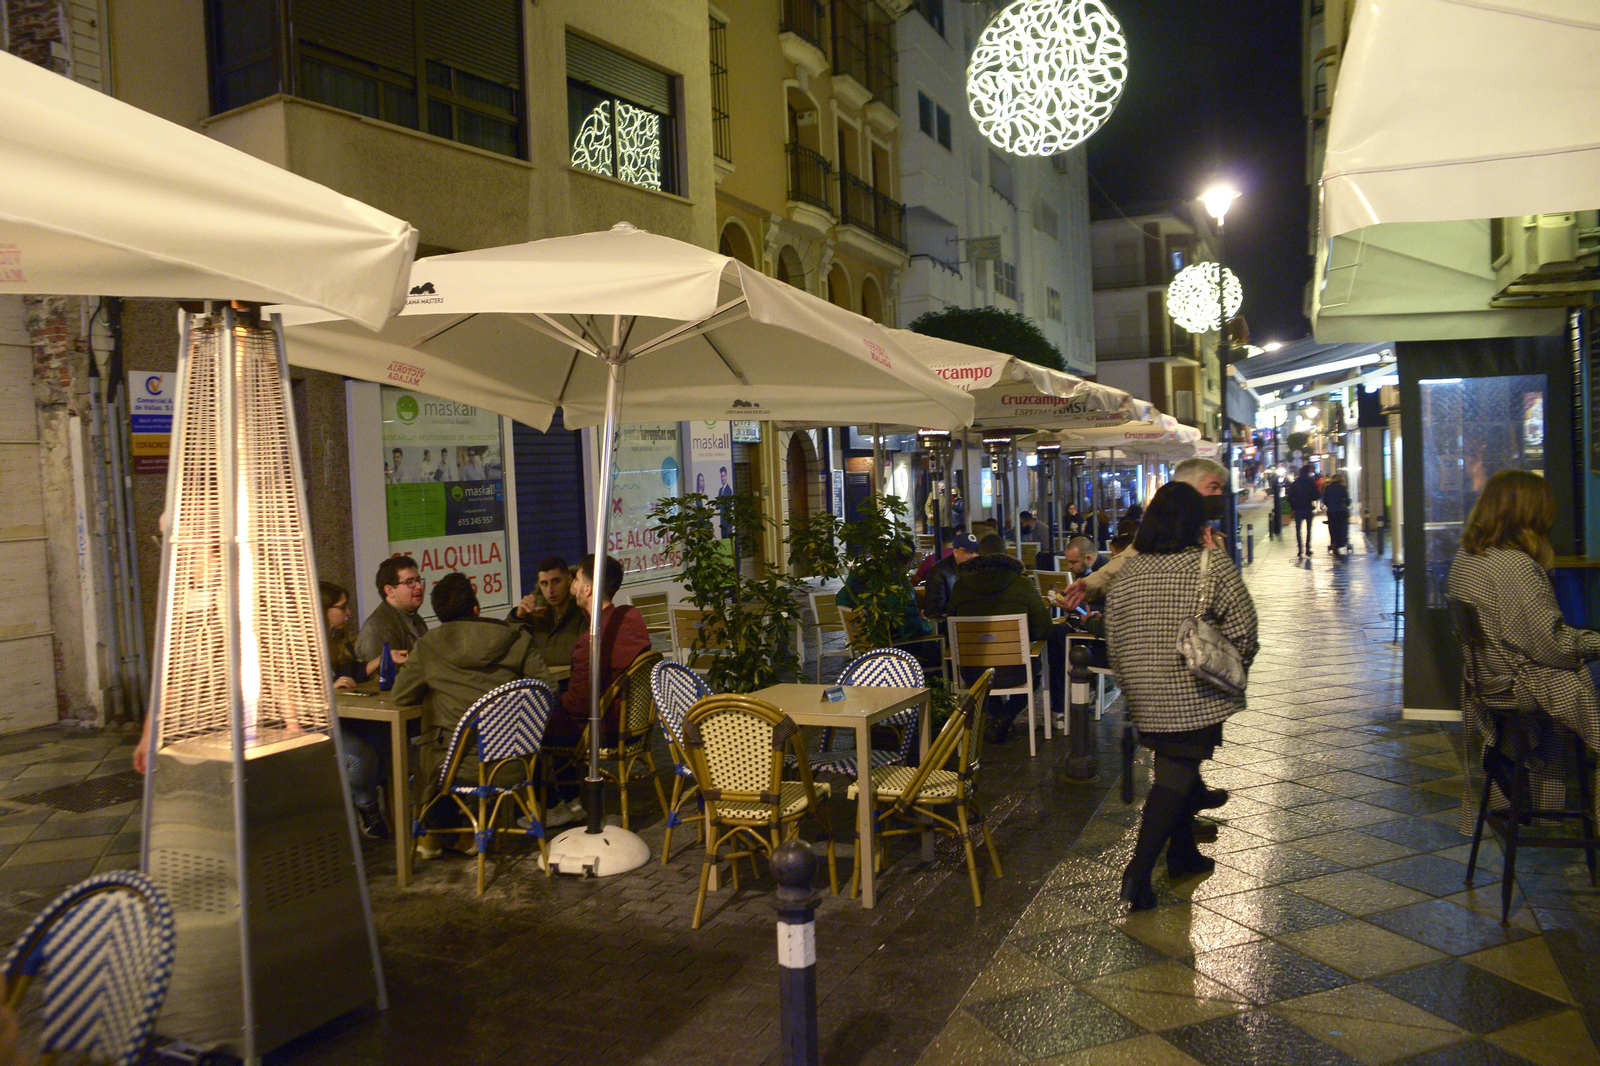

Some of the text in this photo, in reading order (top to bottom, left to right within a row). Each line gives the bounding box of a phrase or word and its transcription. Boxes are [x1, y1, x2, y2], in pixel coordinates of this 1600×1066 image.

[932, 366, 991, 381] zcampo
[1001, 394, 1069, 406] Cruzcampo
[424, 401, 477, 416] maskall
[692, 433, 730, 450] maskall
[465, 483, 496, 497] maskall
[458, 516, 494, 527] 615 245 557
[421, 542, 502, 573] ALQUILA
[635, 554, 648, 574] 31
[483, 573, 503, 595] 85
